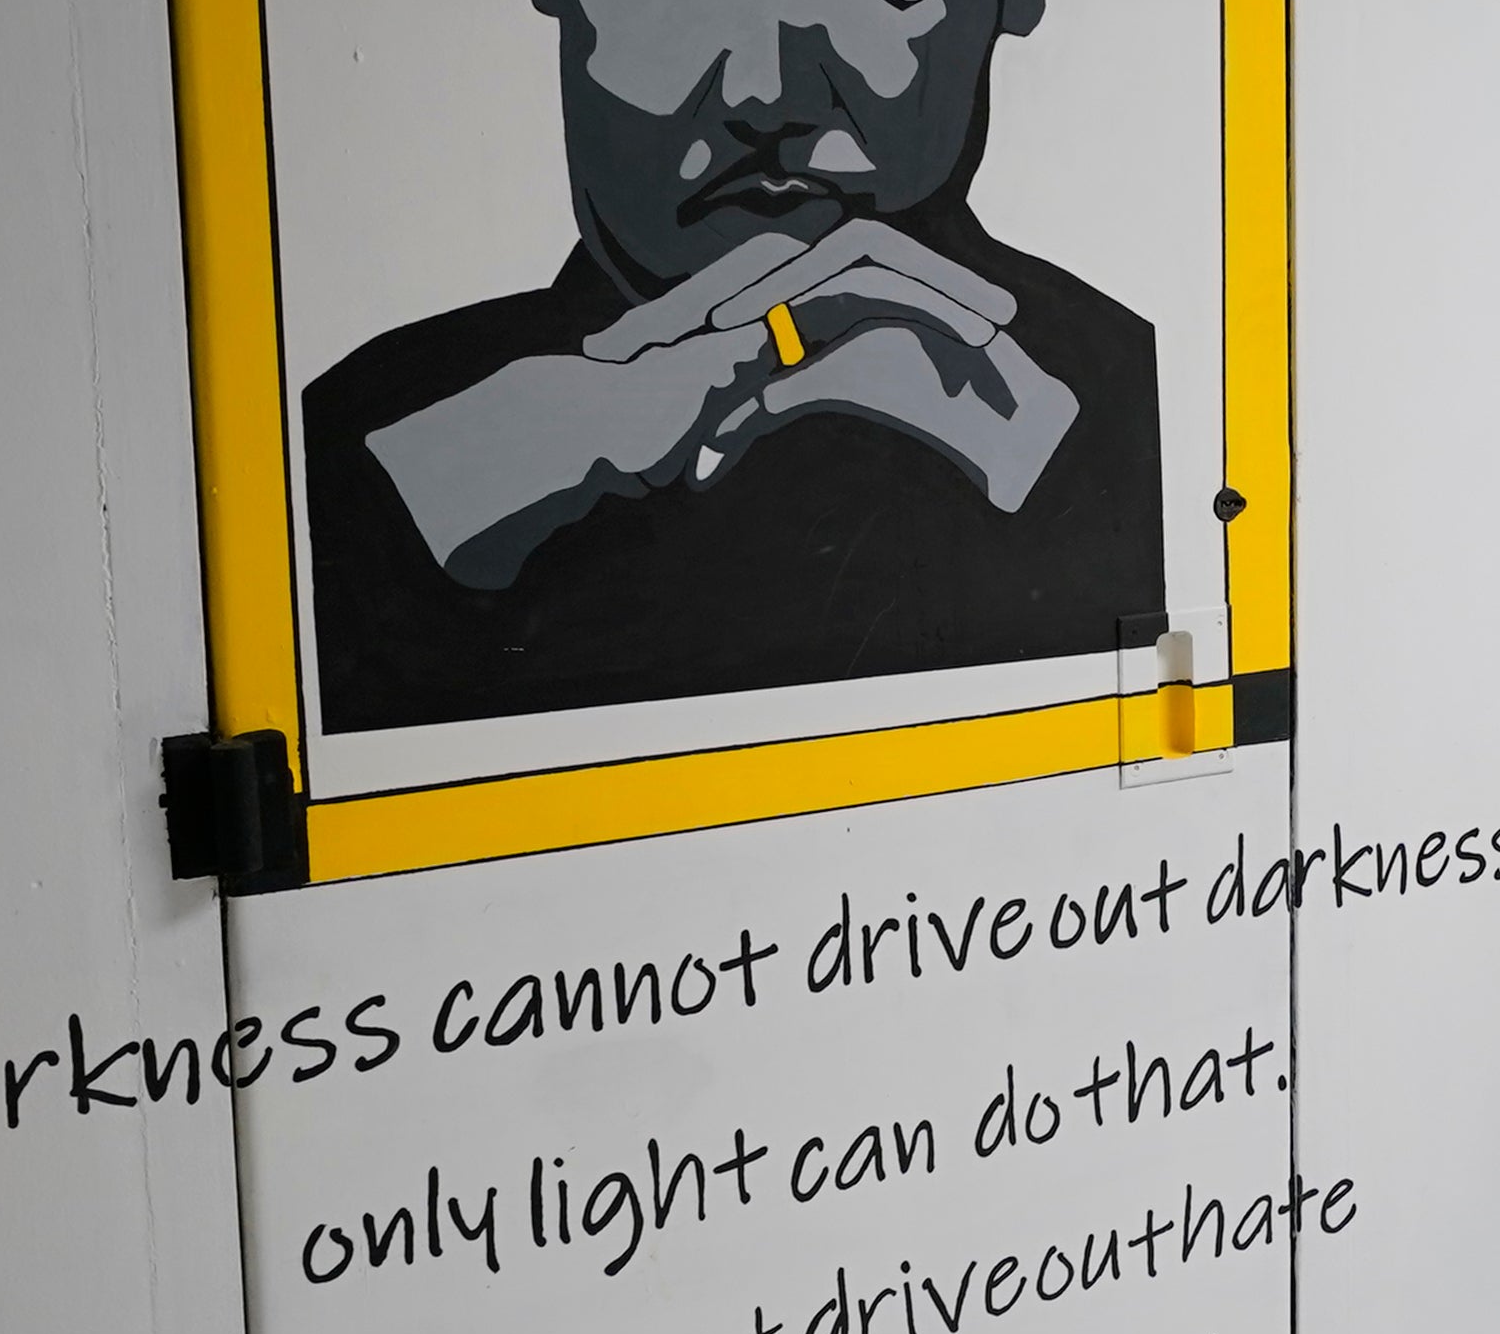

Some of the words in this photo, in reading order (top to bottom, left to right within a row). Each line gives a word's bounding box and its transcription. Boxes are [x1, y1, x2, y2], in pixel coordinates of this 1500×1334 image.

[432, 928, 780, 1054] cannot
[807, 892, 1035, 994] drive
[1049, 858, 1188, 950] out
[302, 1165, 501, 1286] only
[530, 1128, 770, 1278] light
[790, 1119, 936, 1204] can
[974, 1063, 1061, 1159] do
[1072, 1026, 1288, 1127] that.
[1181, 1174, 1357, 1264] hate
